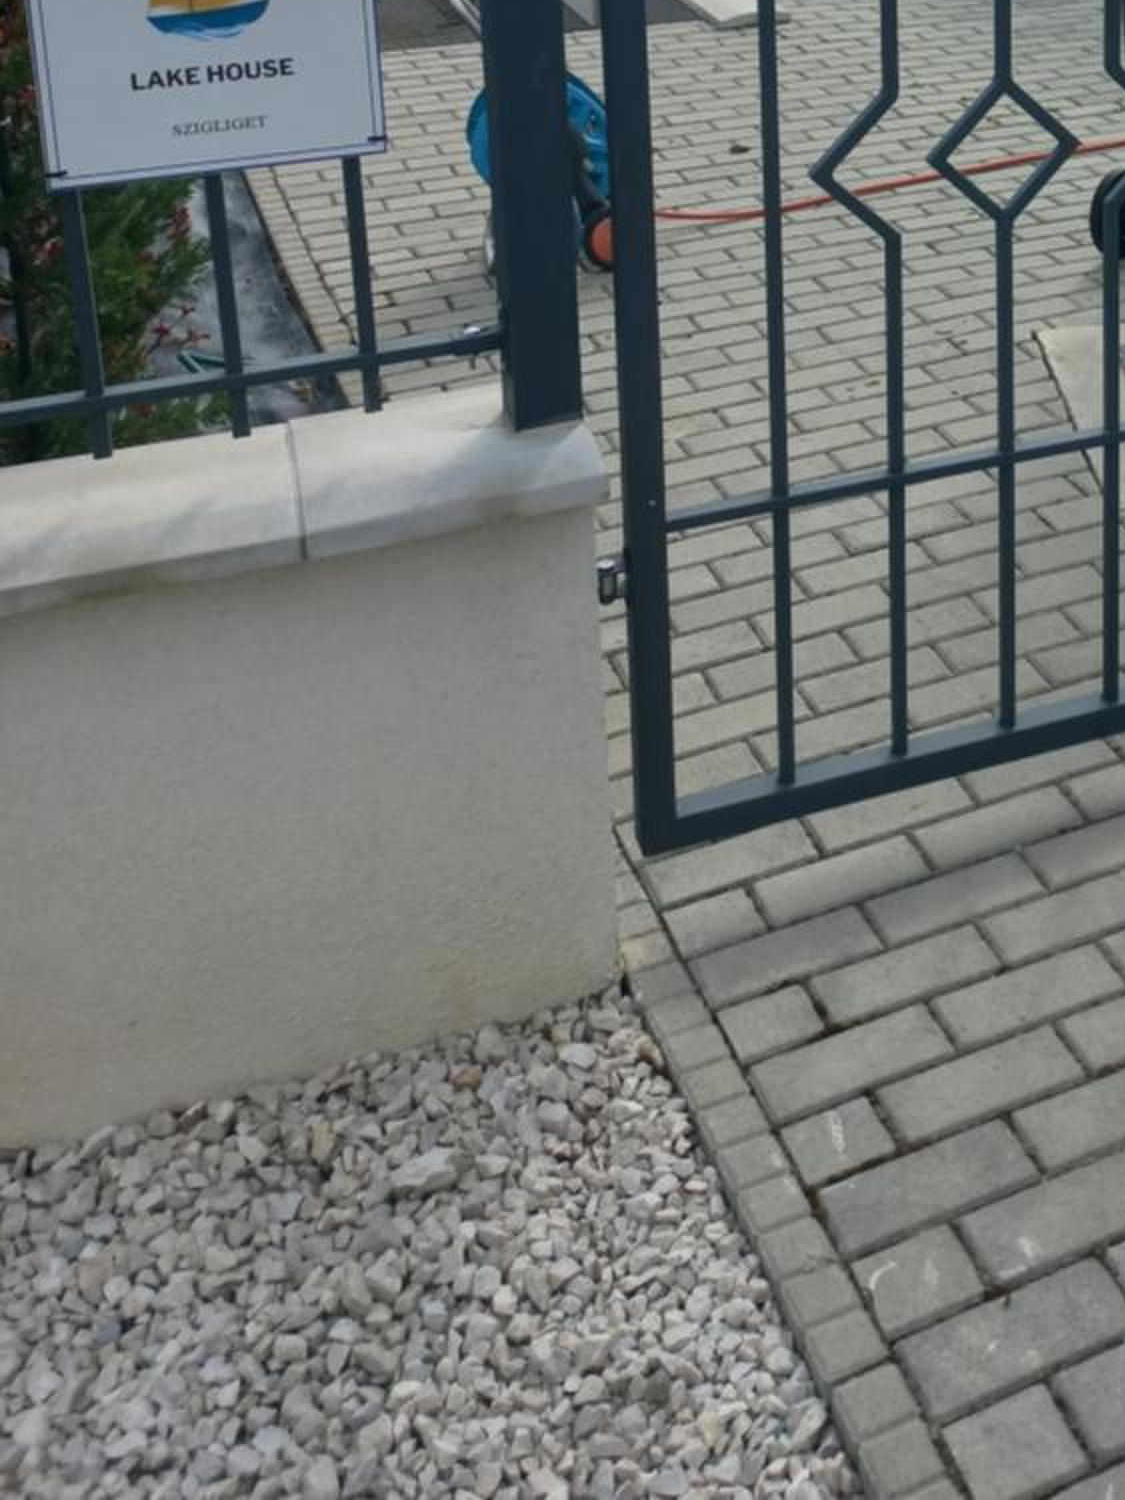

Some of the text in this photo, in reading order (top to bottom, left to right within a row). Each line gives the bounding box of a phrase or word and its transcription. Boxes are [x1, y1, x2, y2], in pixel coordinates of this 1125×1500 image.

[130, 57, 294, 91] LAKE HOUSE
[172, 115, 267, 137] SZIGLIGET
